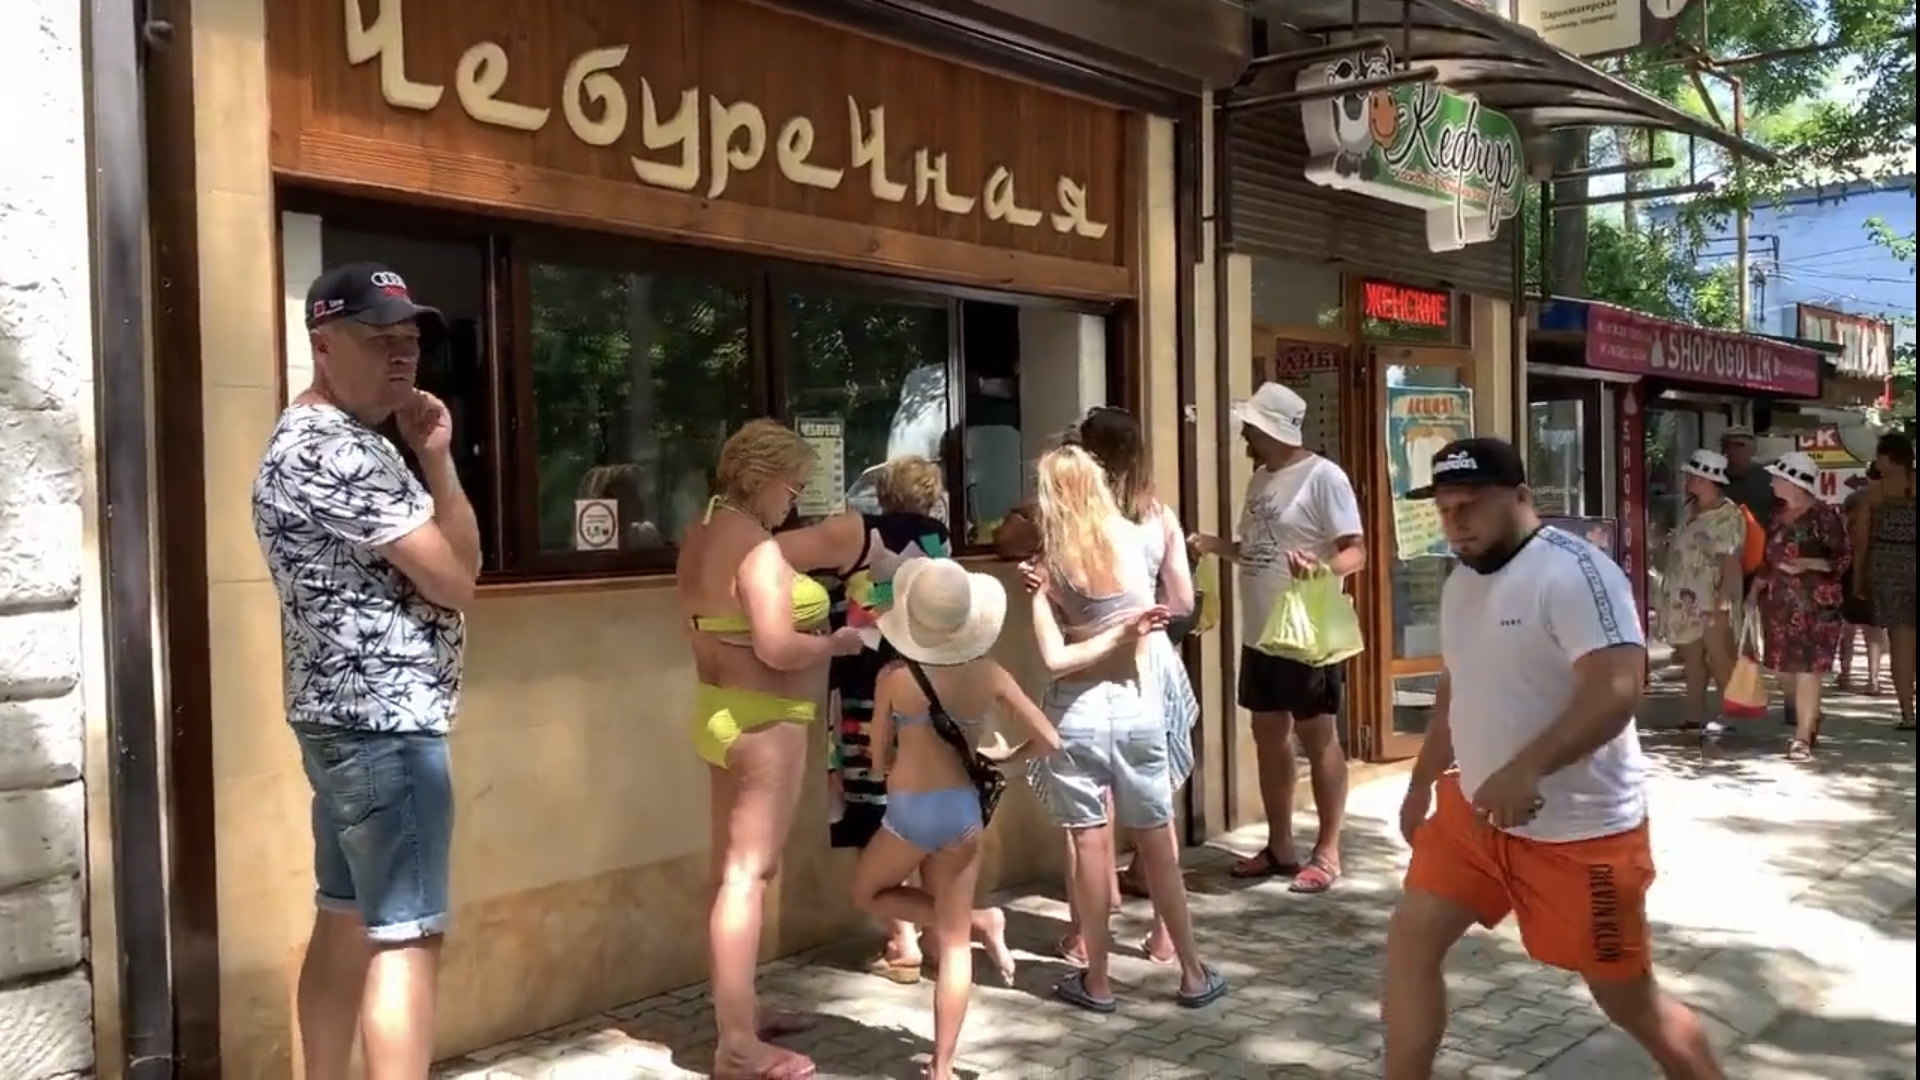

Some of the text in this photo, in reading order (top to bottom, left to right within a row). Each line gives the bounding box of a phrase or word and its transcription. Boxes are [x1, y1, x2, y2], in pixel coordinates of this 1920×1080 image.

[344, 0, 1109, 240] Чебуречная
[1384, 82, 1516, 241] Кефир
[1365, 283, 1447, 327] ЖЕНСКИЕ
[1668, 333, 1772, 382] SHOPOGOLIK
